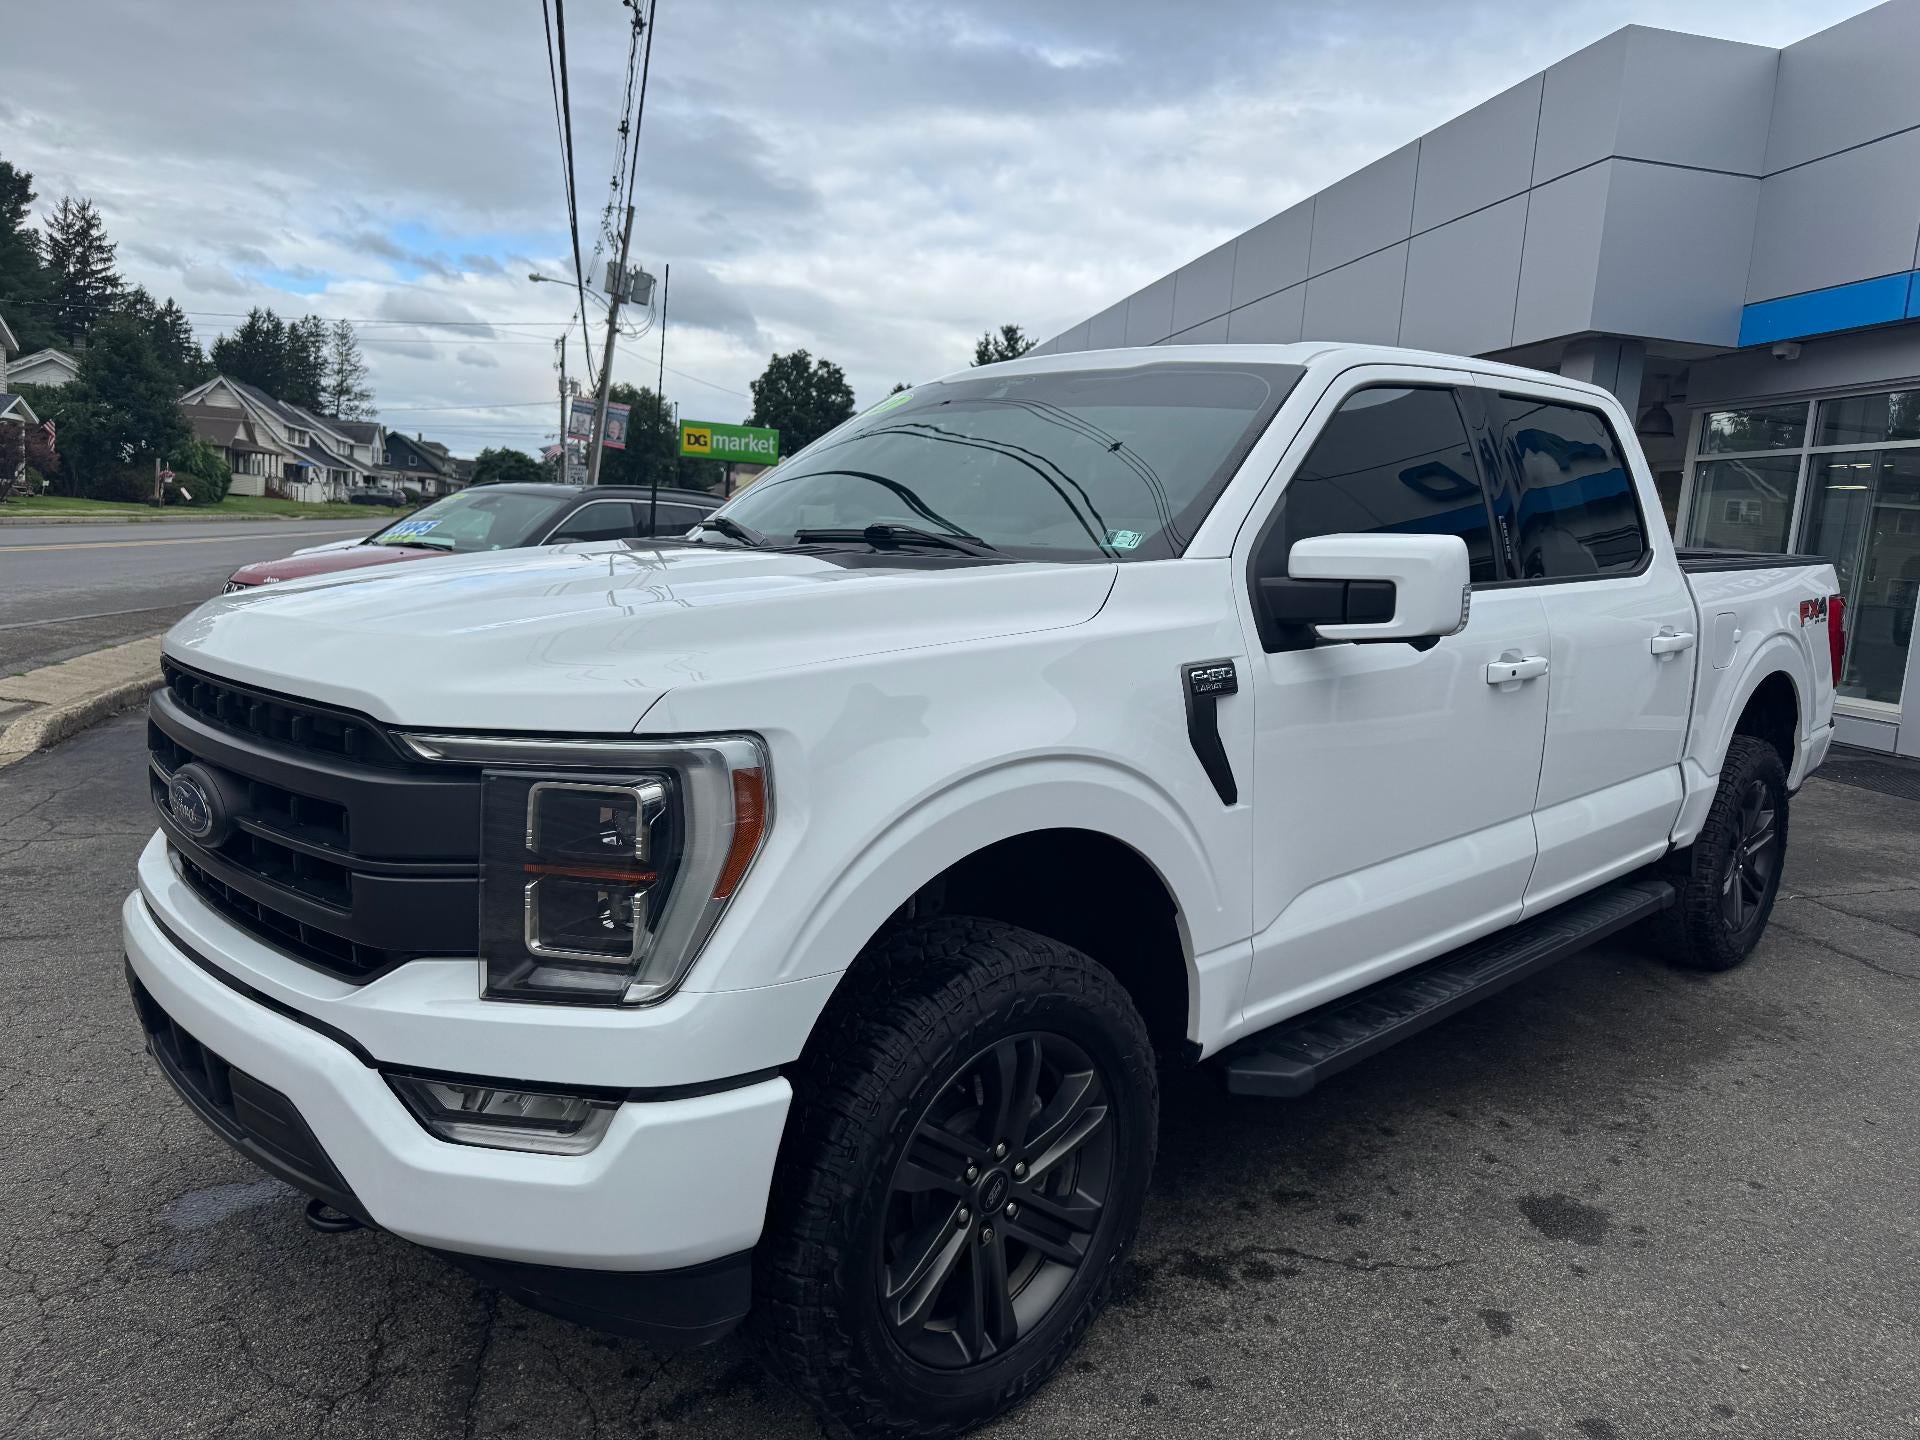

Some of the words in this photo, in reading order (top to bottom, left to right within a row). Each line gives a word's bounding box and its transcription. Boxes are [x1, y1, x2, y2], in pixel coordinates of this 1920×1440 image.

[687, 433, 708, 447] DG
[712, 433, 775, 454] market
[569, 476, 585, 485] 35
[1799, 597, 1827, 627] FX4
[1195, 682, 1222, 692] LARIAT
